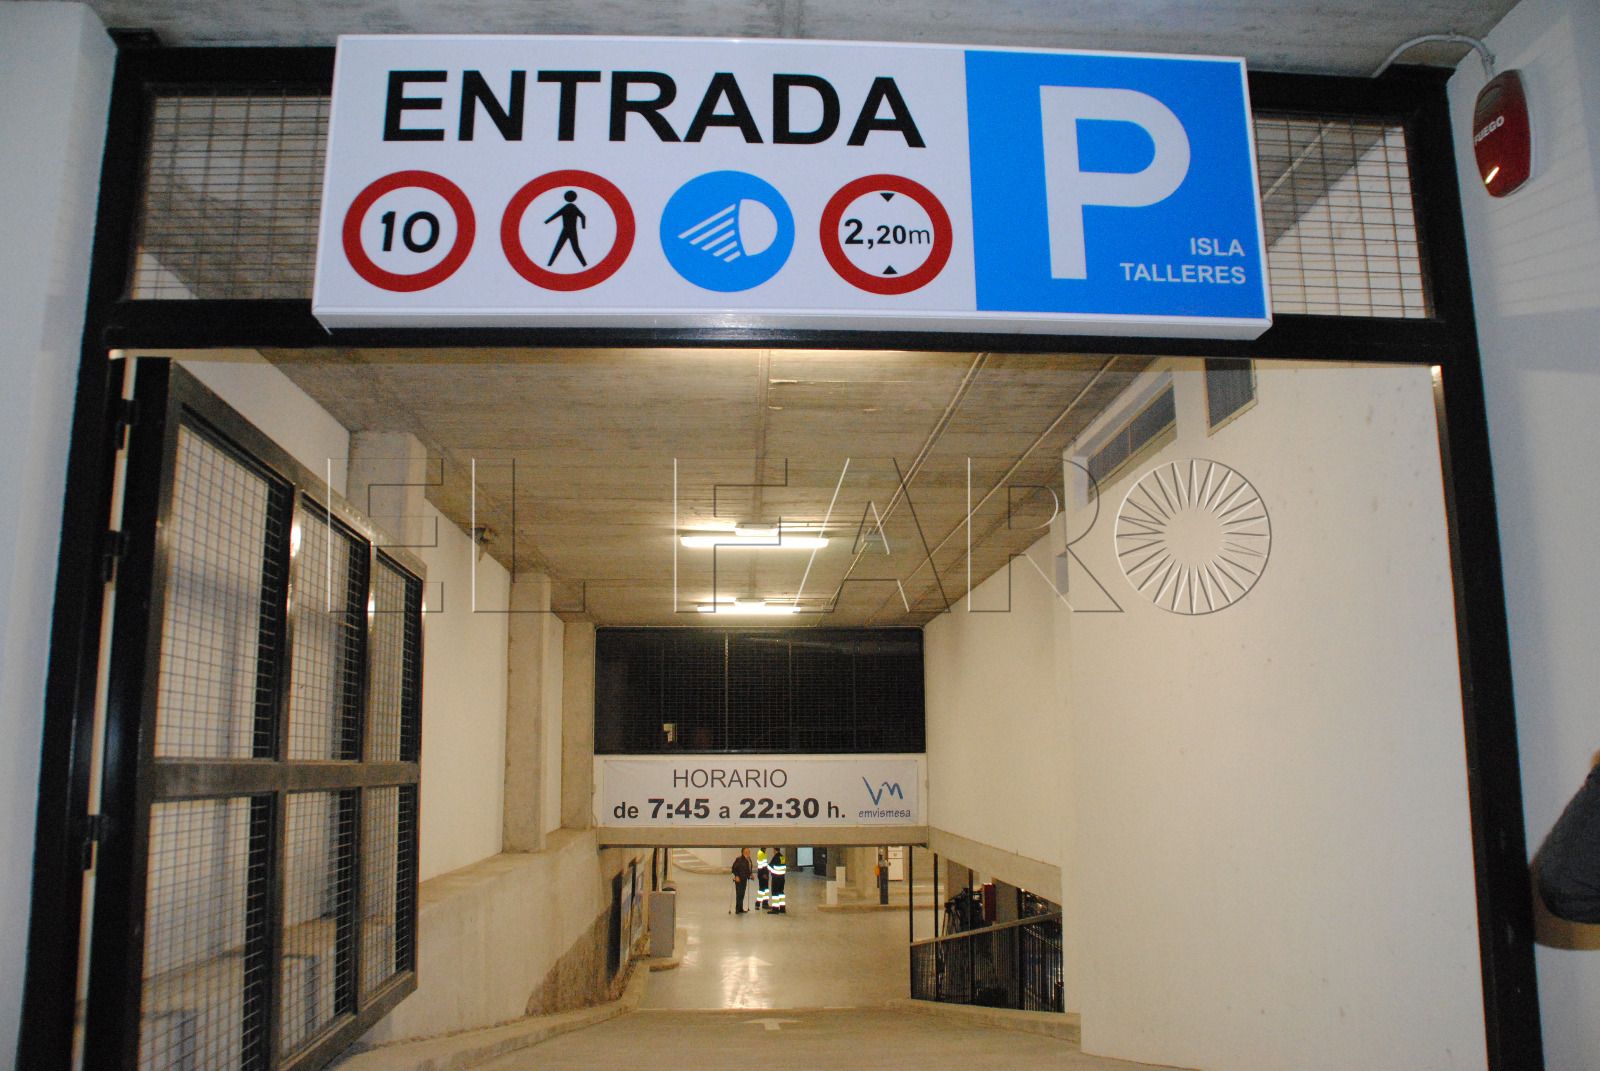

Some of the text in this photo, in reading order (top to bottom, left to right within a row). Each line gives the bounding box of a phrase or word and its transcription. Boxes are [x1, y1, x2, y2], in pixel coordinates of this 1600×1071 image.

[383, 70, 926, 148] ENTRADA
[1039, 85, 1192, 281] P
[381, 211, 441, 253] 10
[843, 217, 932, 249] 2,20m
[1190, 238, 1246, 257] ISLA
[1119, 262, 1247, 284] TALLERES
[673, 769, 788, 789] HORARIO
[613, 797, 846, 819] de 7:45 a 22:30 h.
[858, 807, 911, 818] emvismesa
